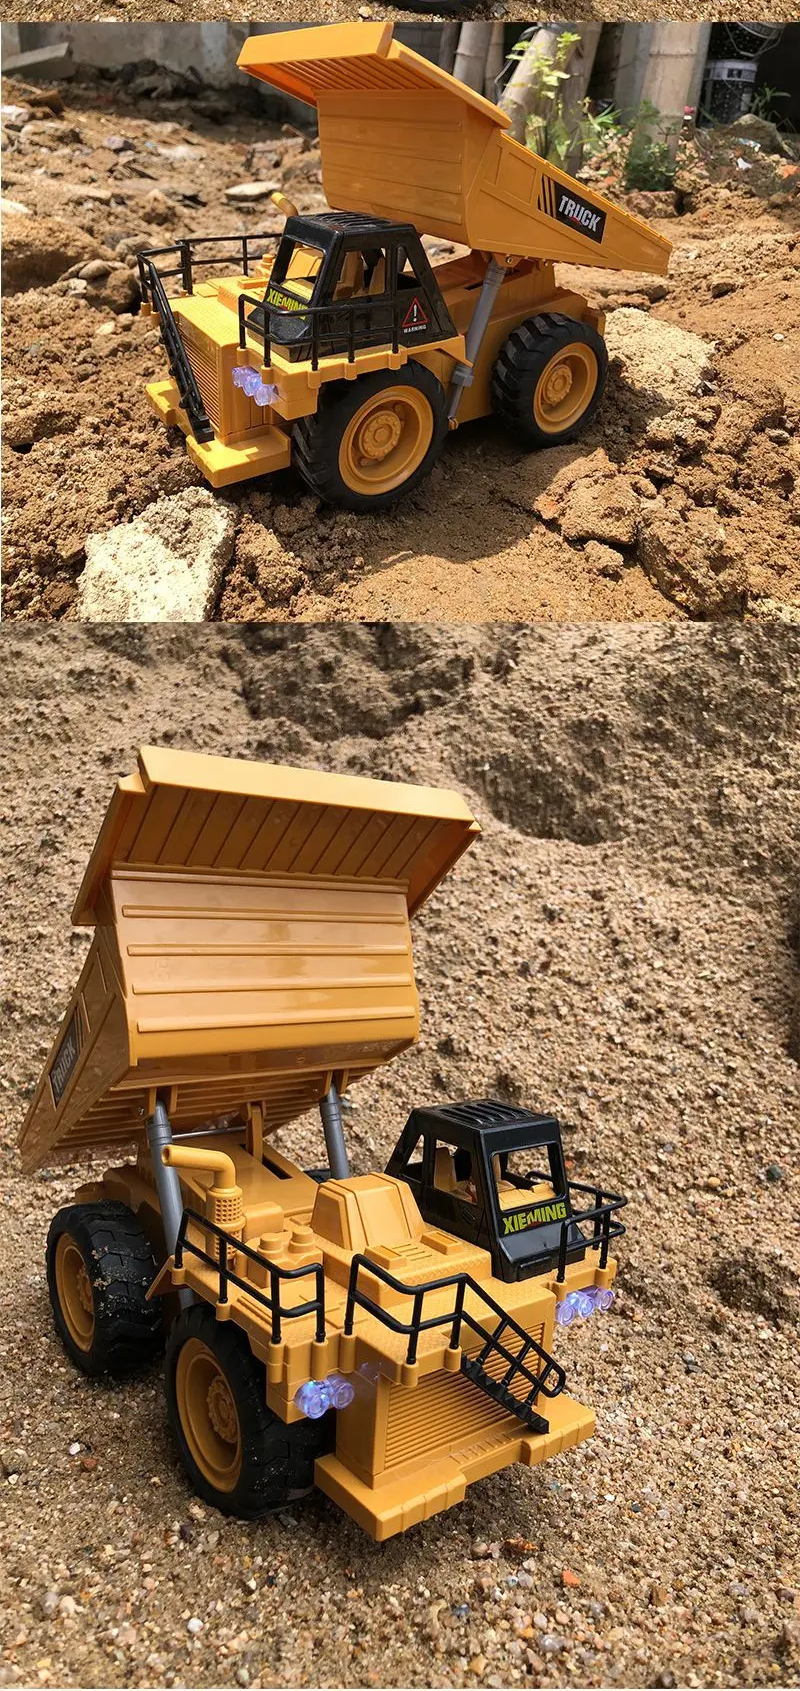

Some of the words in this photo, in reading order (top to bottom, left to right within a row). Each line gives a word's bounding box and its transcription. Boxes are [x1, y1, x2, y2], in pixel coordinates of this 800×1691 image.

[558, 195, 601, 232] TRUCK
[53, 1036, 76, 1093] TRUCK
[502, 1202, 567, 1235] XIEMING
